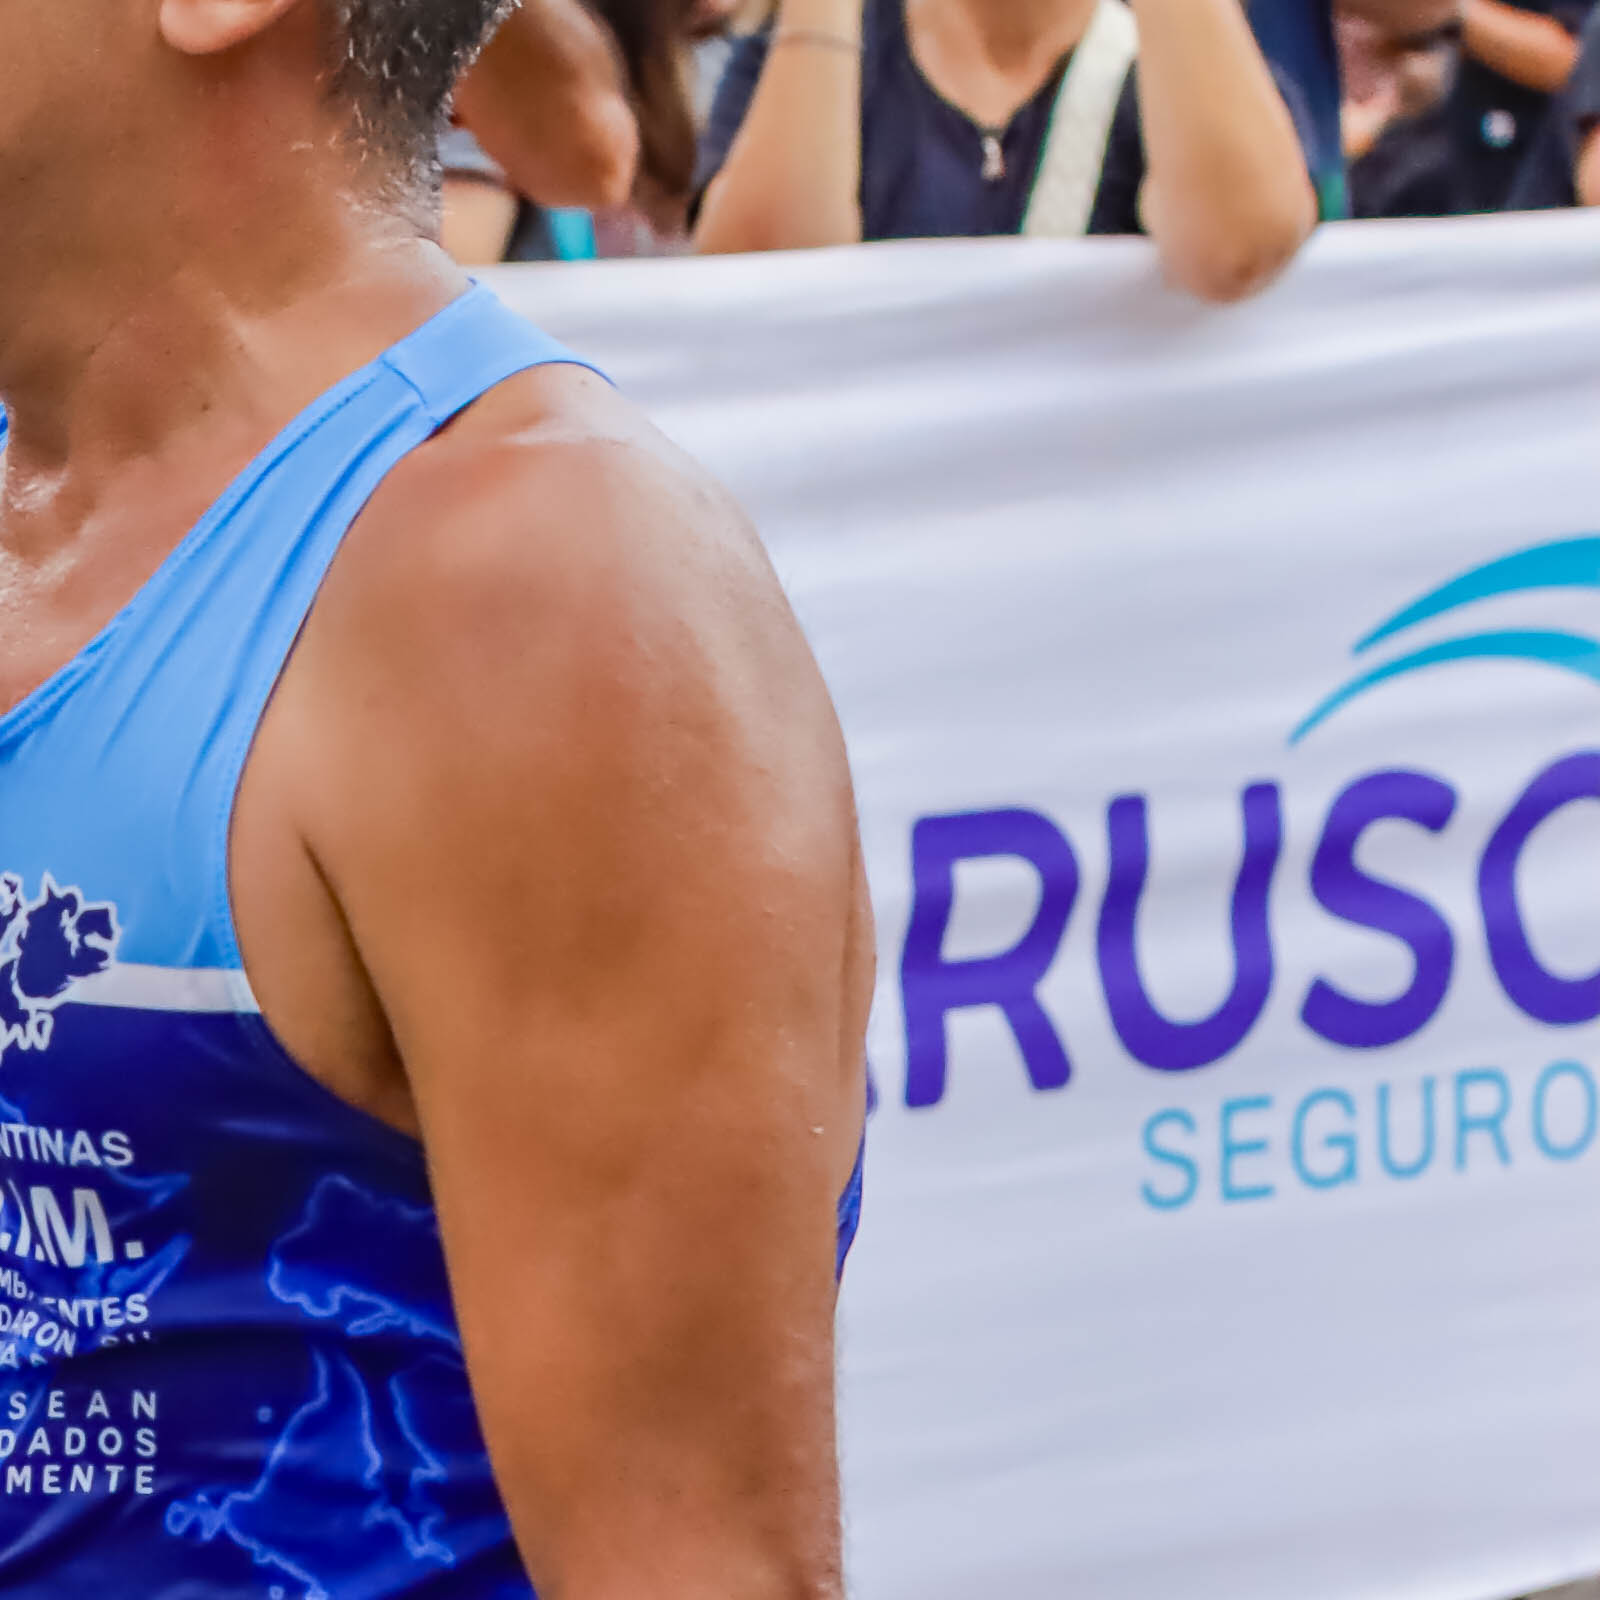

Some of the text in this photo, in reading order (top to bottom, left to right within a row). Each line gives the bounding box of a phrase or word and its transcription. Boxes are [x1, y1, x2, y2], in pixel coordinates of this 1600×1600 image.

[866, 746, 1600, 1114] RUSO
[1141, 1058, 1599, 1211] SEGURO
[7, 1389, 157, 1420] SEAN
